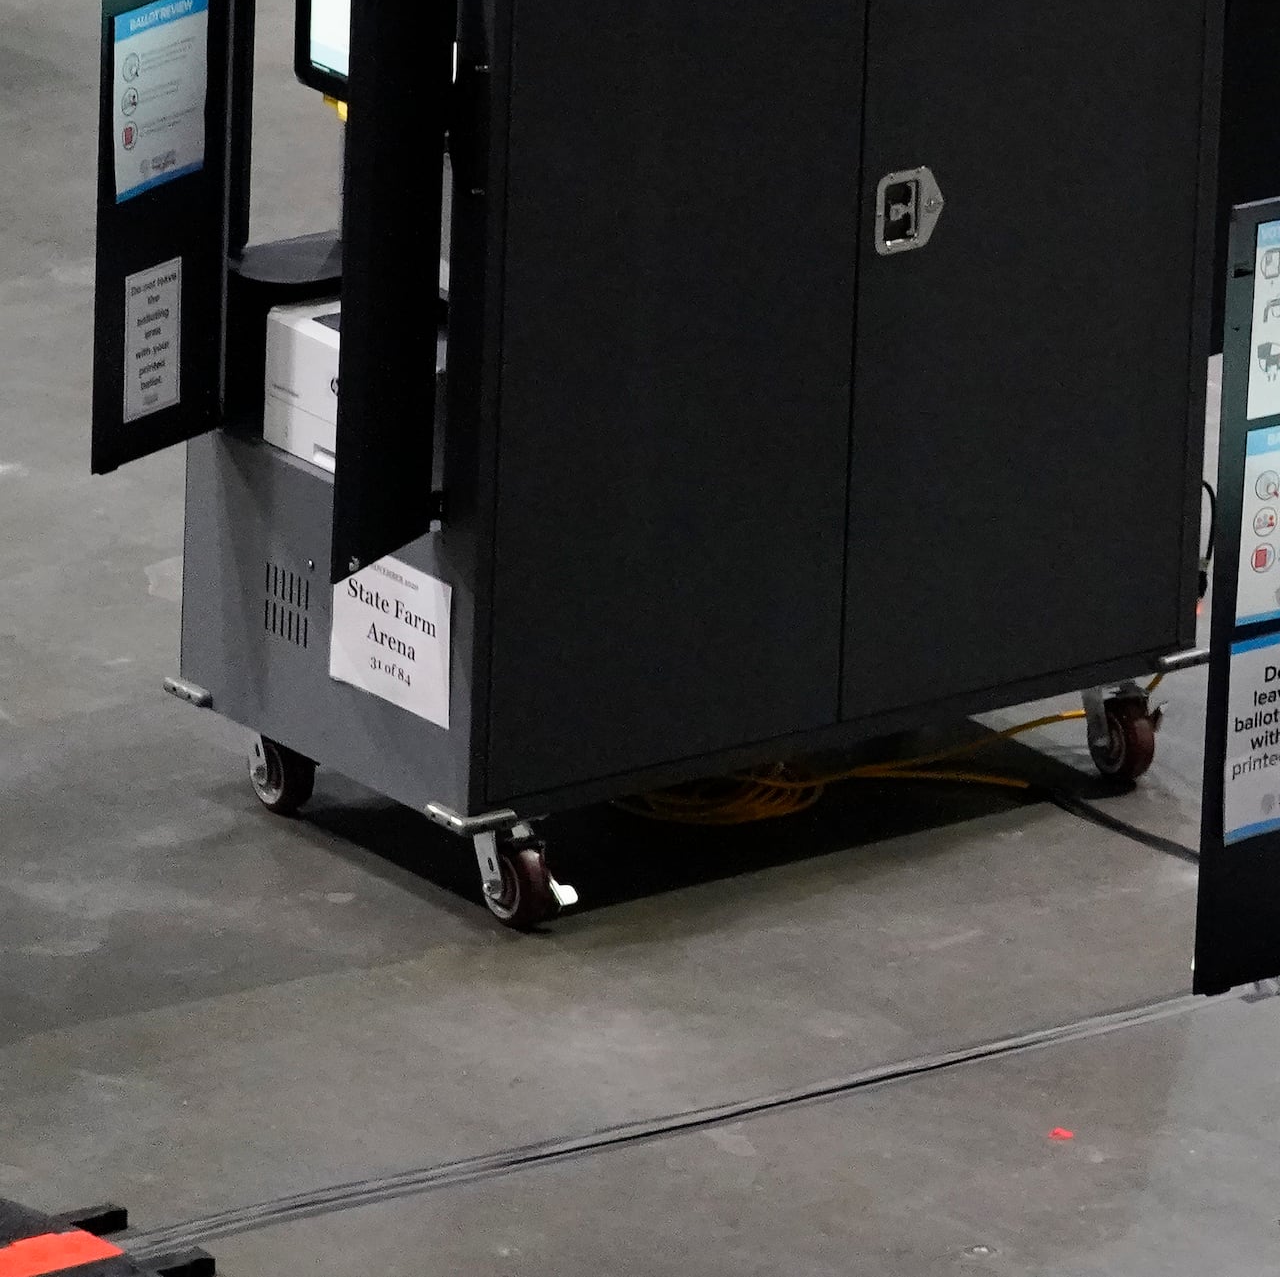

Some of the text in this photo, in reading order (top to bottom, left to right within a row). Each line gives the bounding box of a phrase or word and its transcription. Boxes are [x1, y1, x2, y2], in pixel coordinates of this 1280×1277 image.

[162, 0, 192, 20] REVIEW
[347, 576, 436, 638] State Farm
[367, 622, 415, 661] Arena
[370, 655, 411, 687] 31 of 84
